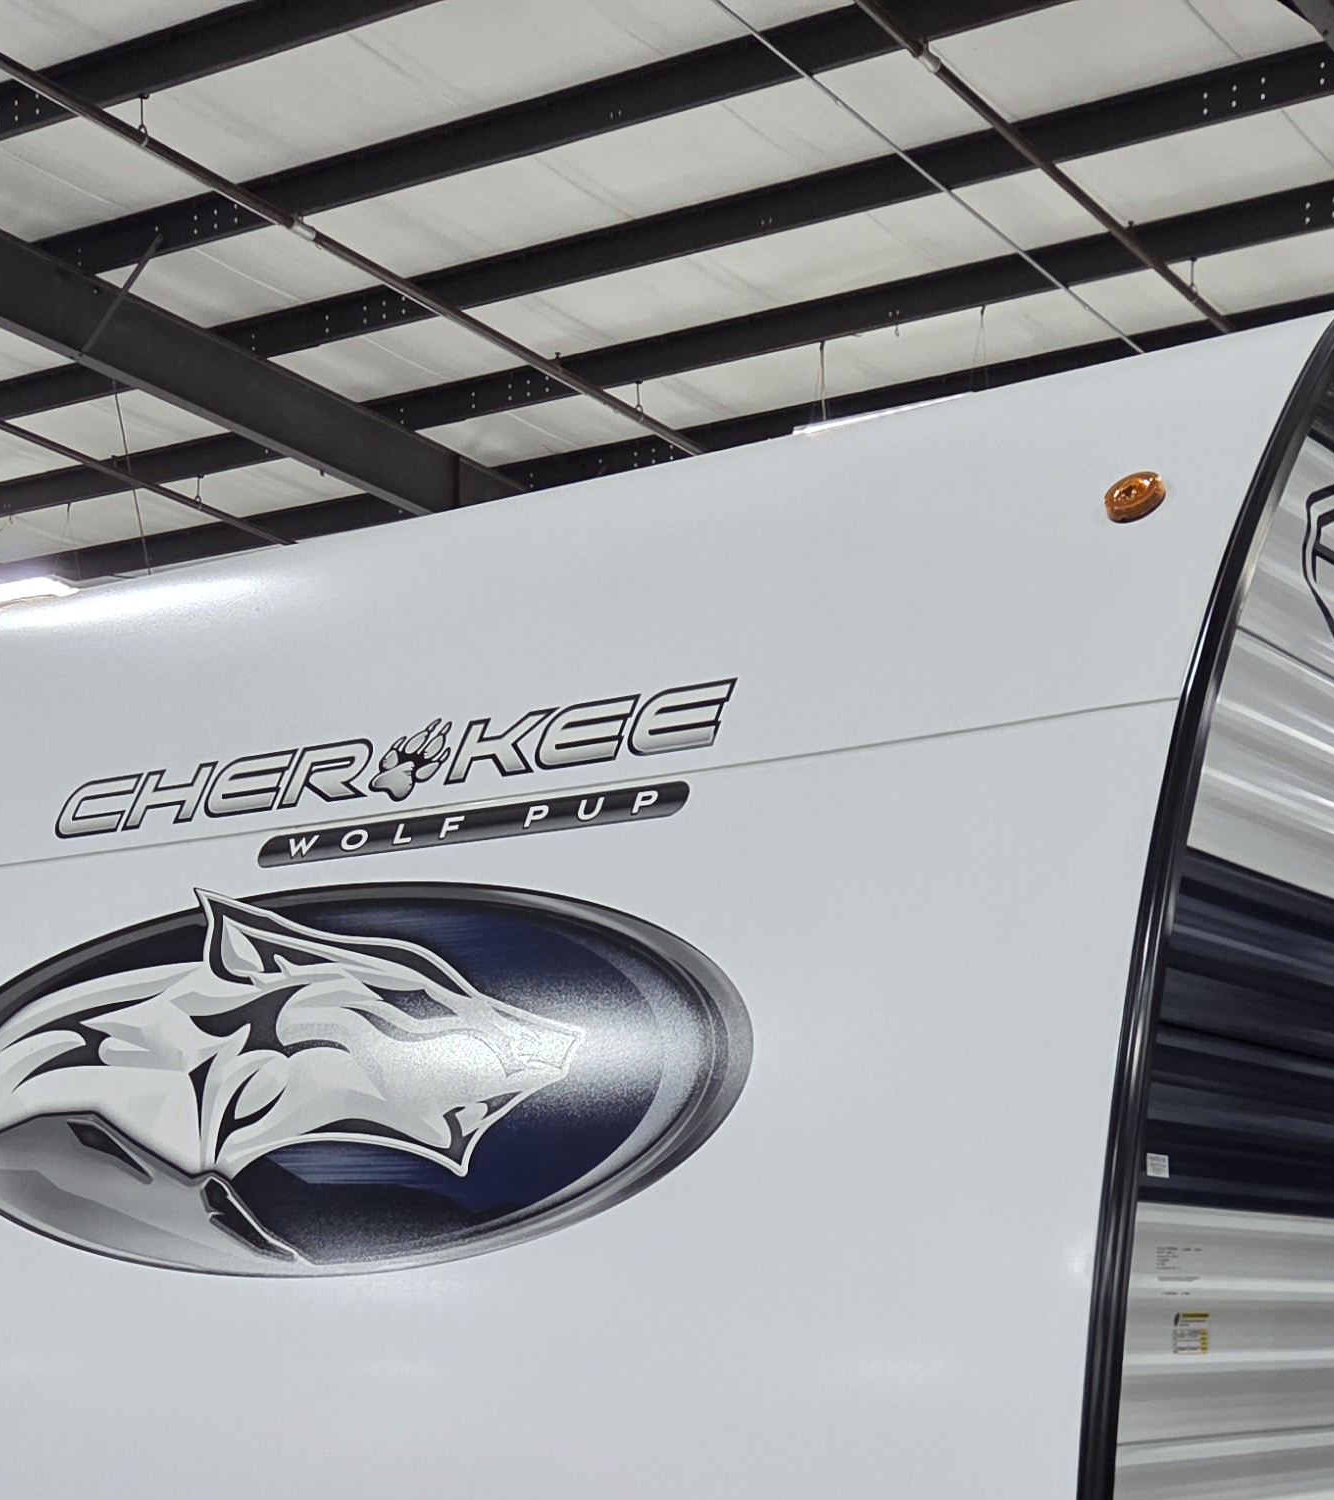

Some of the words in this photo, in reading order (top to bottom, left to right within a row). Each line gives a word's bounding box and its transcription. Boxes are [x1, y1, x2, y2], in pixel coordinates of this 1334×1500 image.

[55, 678, 738, 839] CHEROKEE
[287, 815, 465, 858] WOLF
[522, 790, 660, 829] PUP
